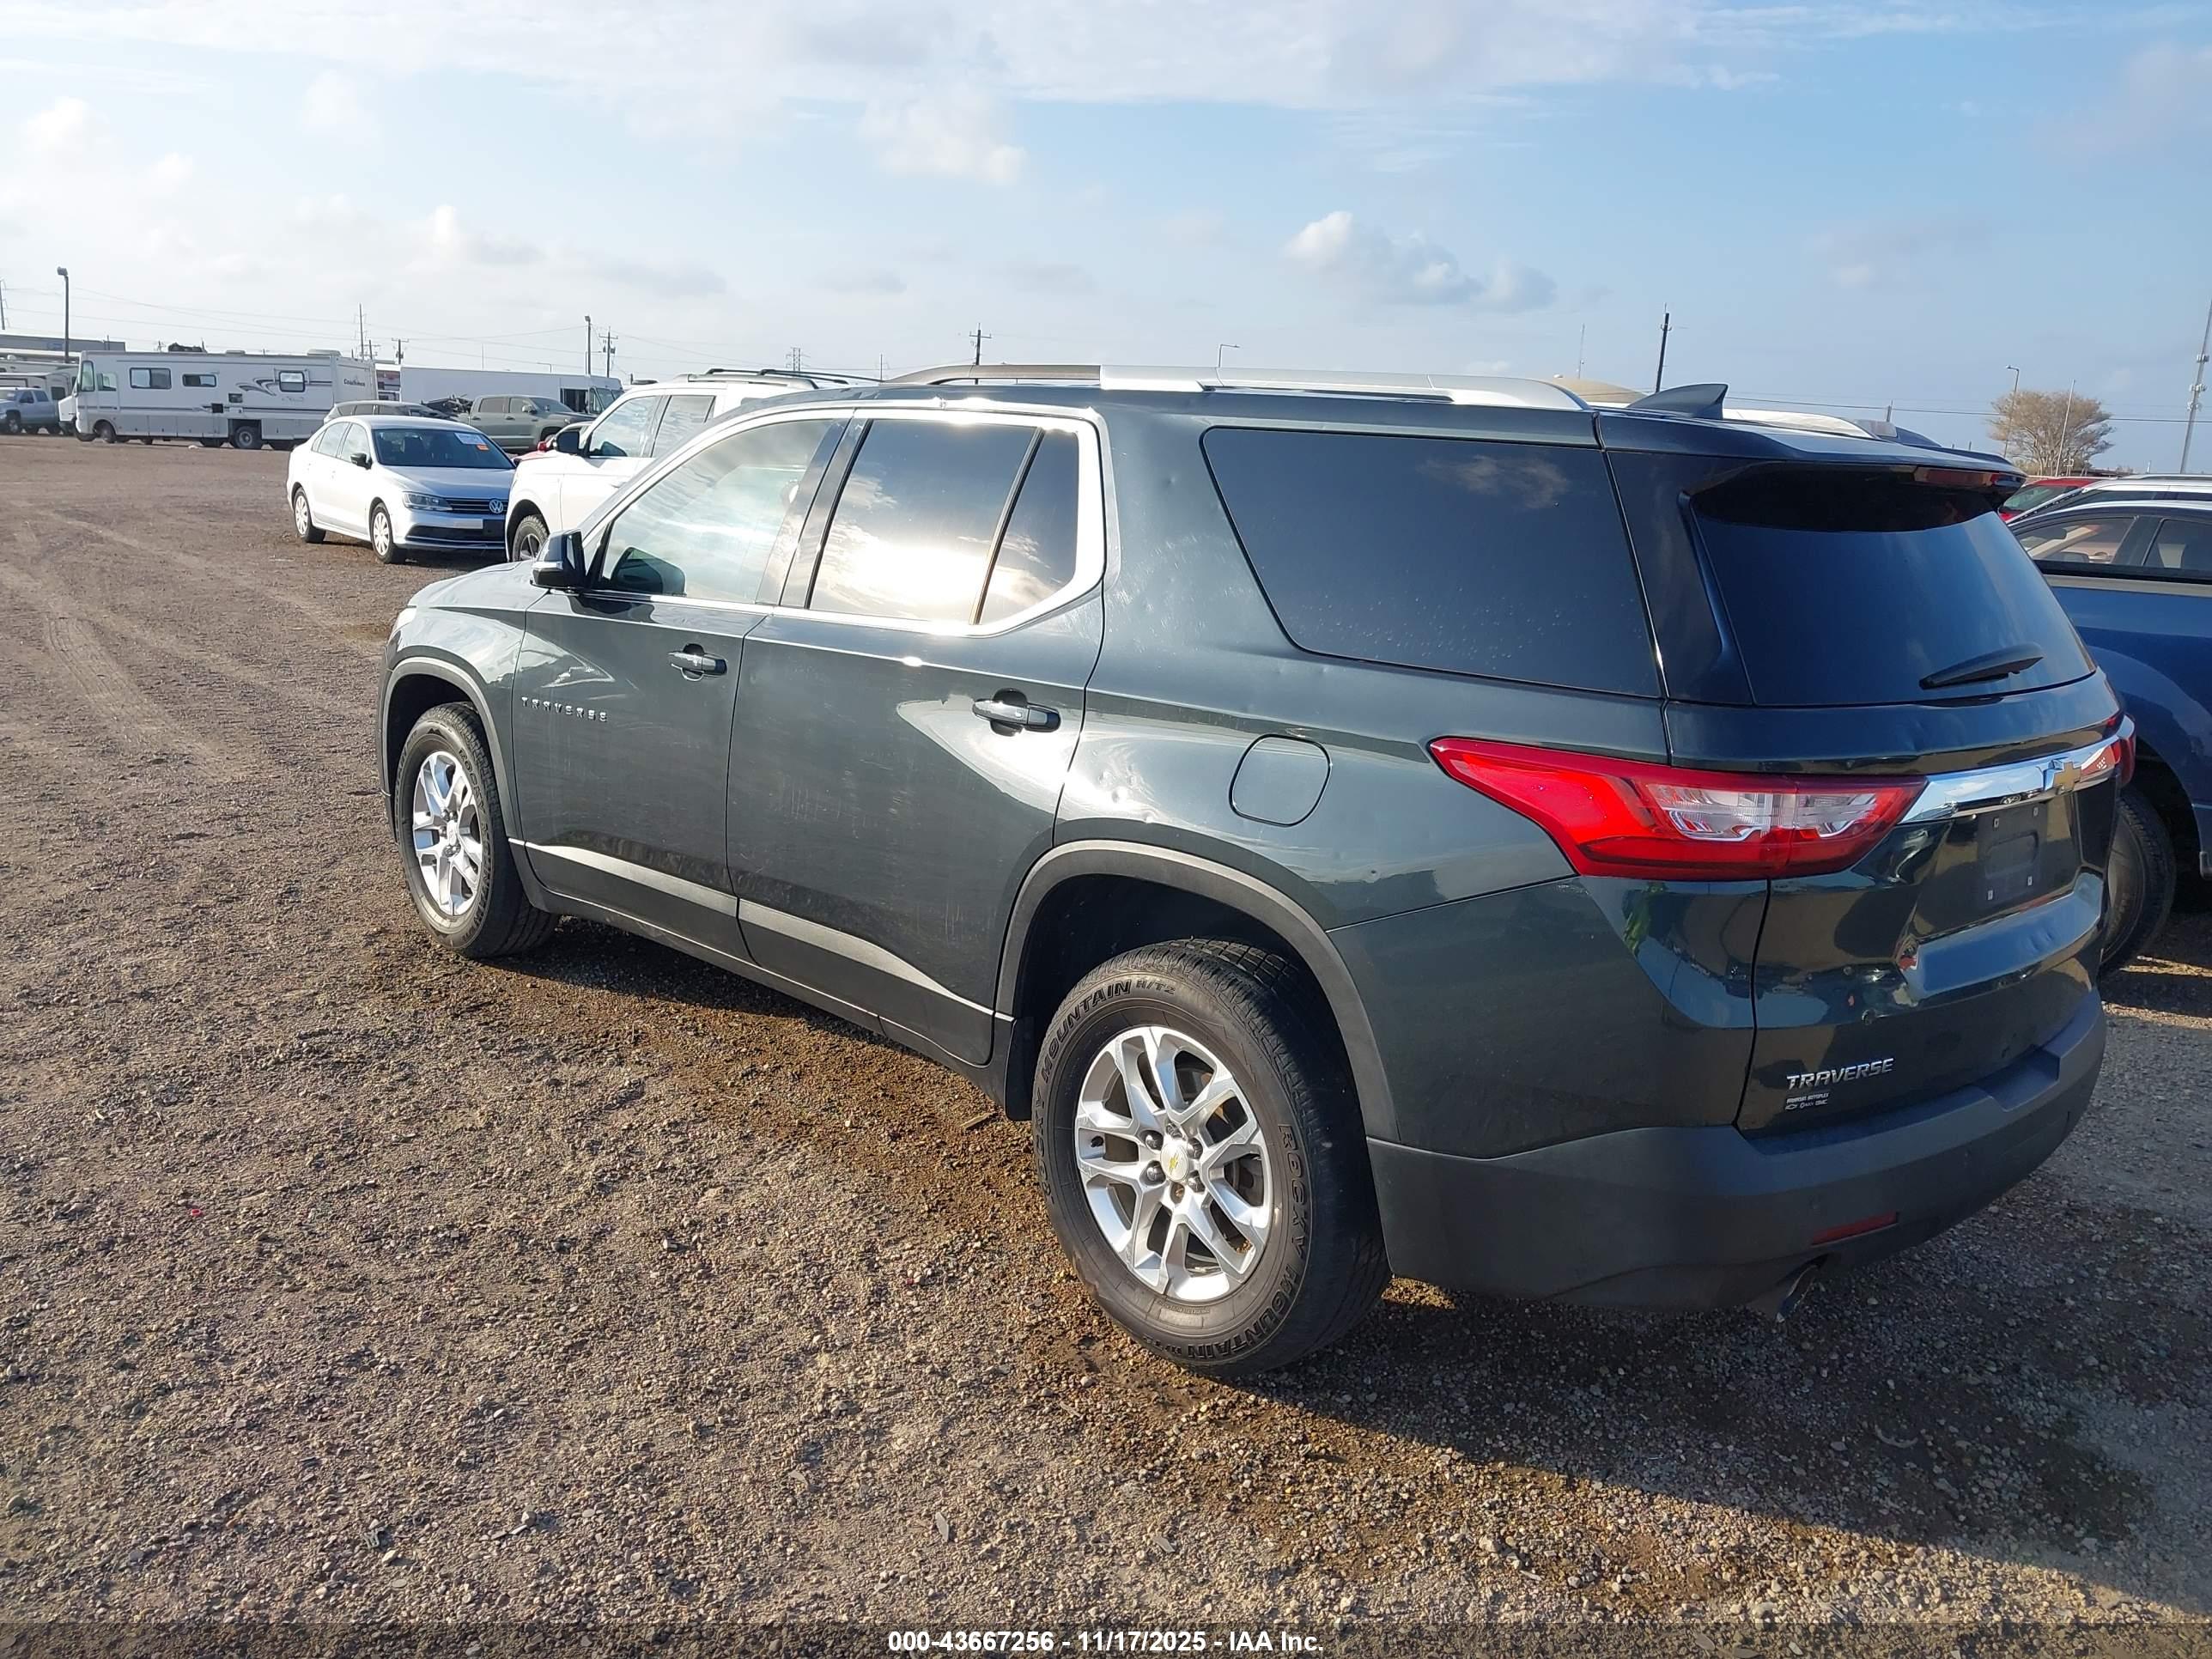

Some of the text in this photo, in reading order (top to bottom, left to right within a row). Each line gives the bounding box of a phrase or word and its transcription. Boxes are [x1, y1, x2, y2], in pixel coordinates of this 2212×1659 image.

[521, 696, 608, 722] TRAVERSE
[1041, 978, 1133, 1084] MOUNTAIN
[1786, 1057, 1894, 1091] TRAVERSE
[1278, 1123, 1307, 1260] ROCKY
[1187, 1265, 1300, 1360] MOUNTAIN
